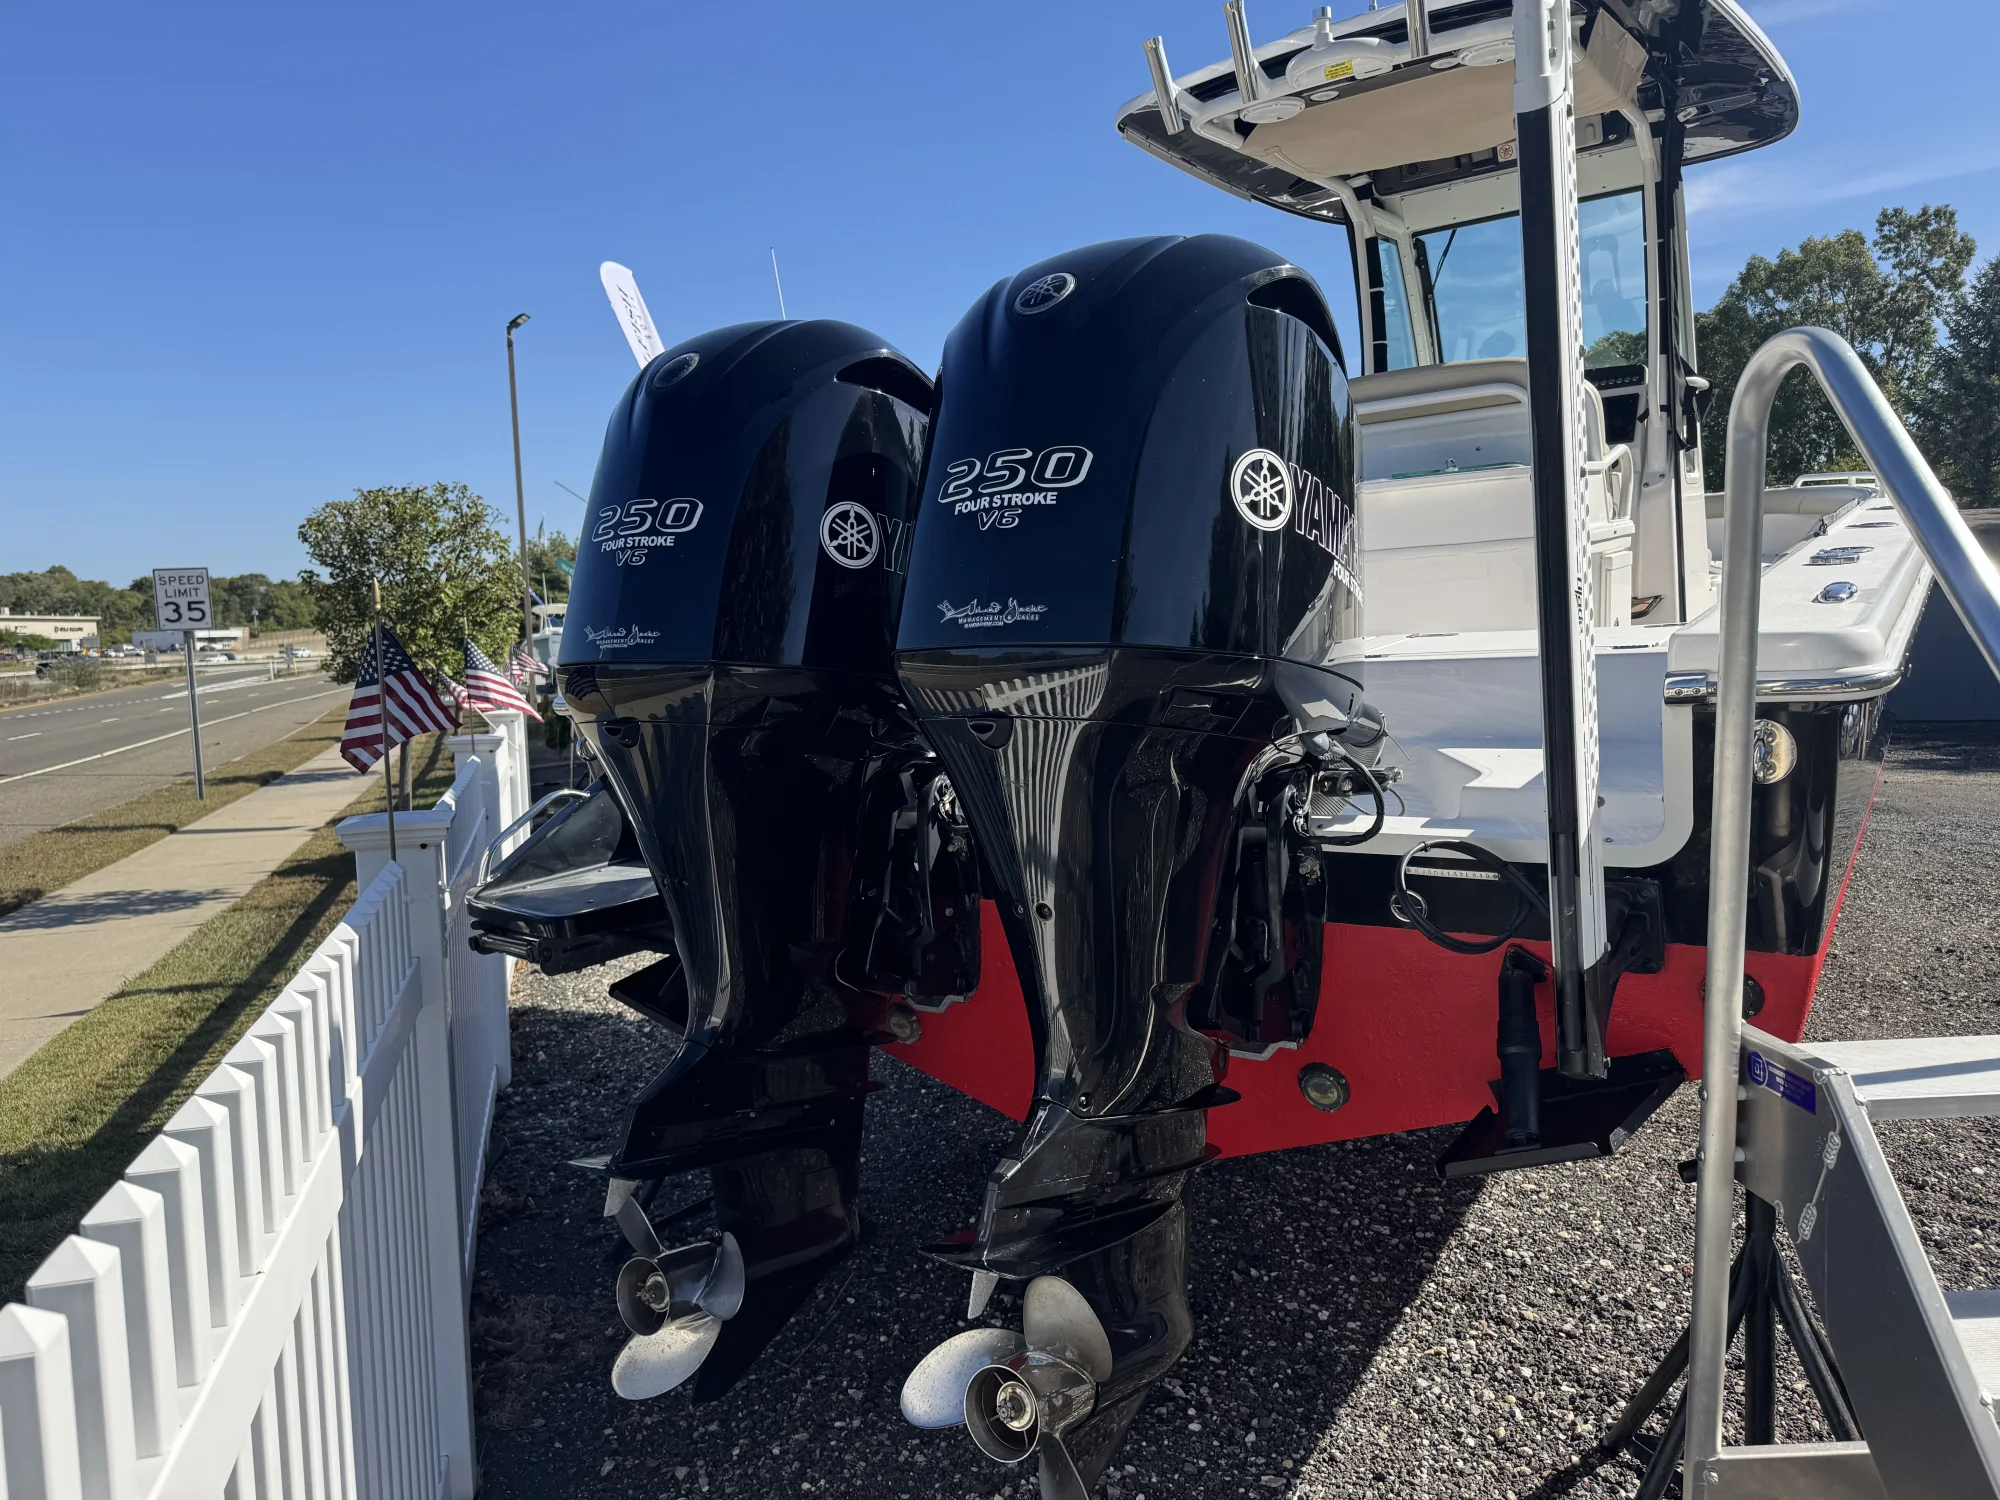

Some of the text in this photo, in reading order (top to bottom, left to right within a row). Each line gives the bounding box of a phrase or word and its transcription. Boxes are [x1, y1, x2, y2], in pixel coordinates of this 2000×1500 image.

[938, 446, 1094, 503] 250
[954, 492, 1058, 515] FOUR STROKE
[592, 498, 704, 542] 250
[978, 508, 1023, 531] V6
[601, 536, 675, 552] FOUR STROKE
[616, 549, 648, 566] V6
[158, 575, 205, 586] SPEED
[1333, 559, 1350, 588] FOUR
[164, 588, 200, 598] LIMIT
[163, 601, 206, 623] 35
[958, 615, 1003, 624] MANAGEMENT
